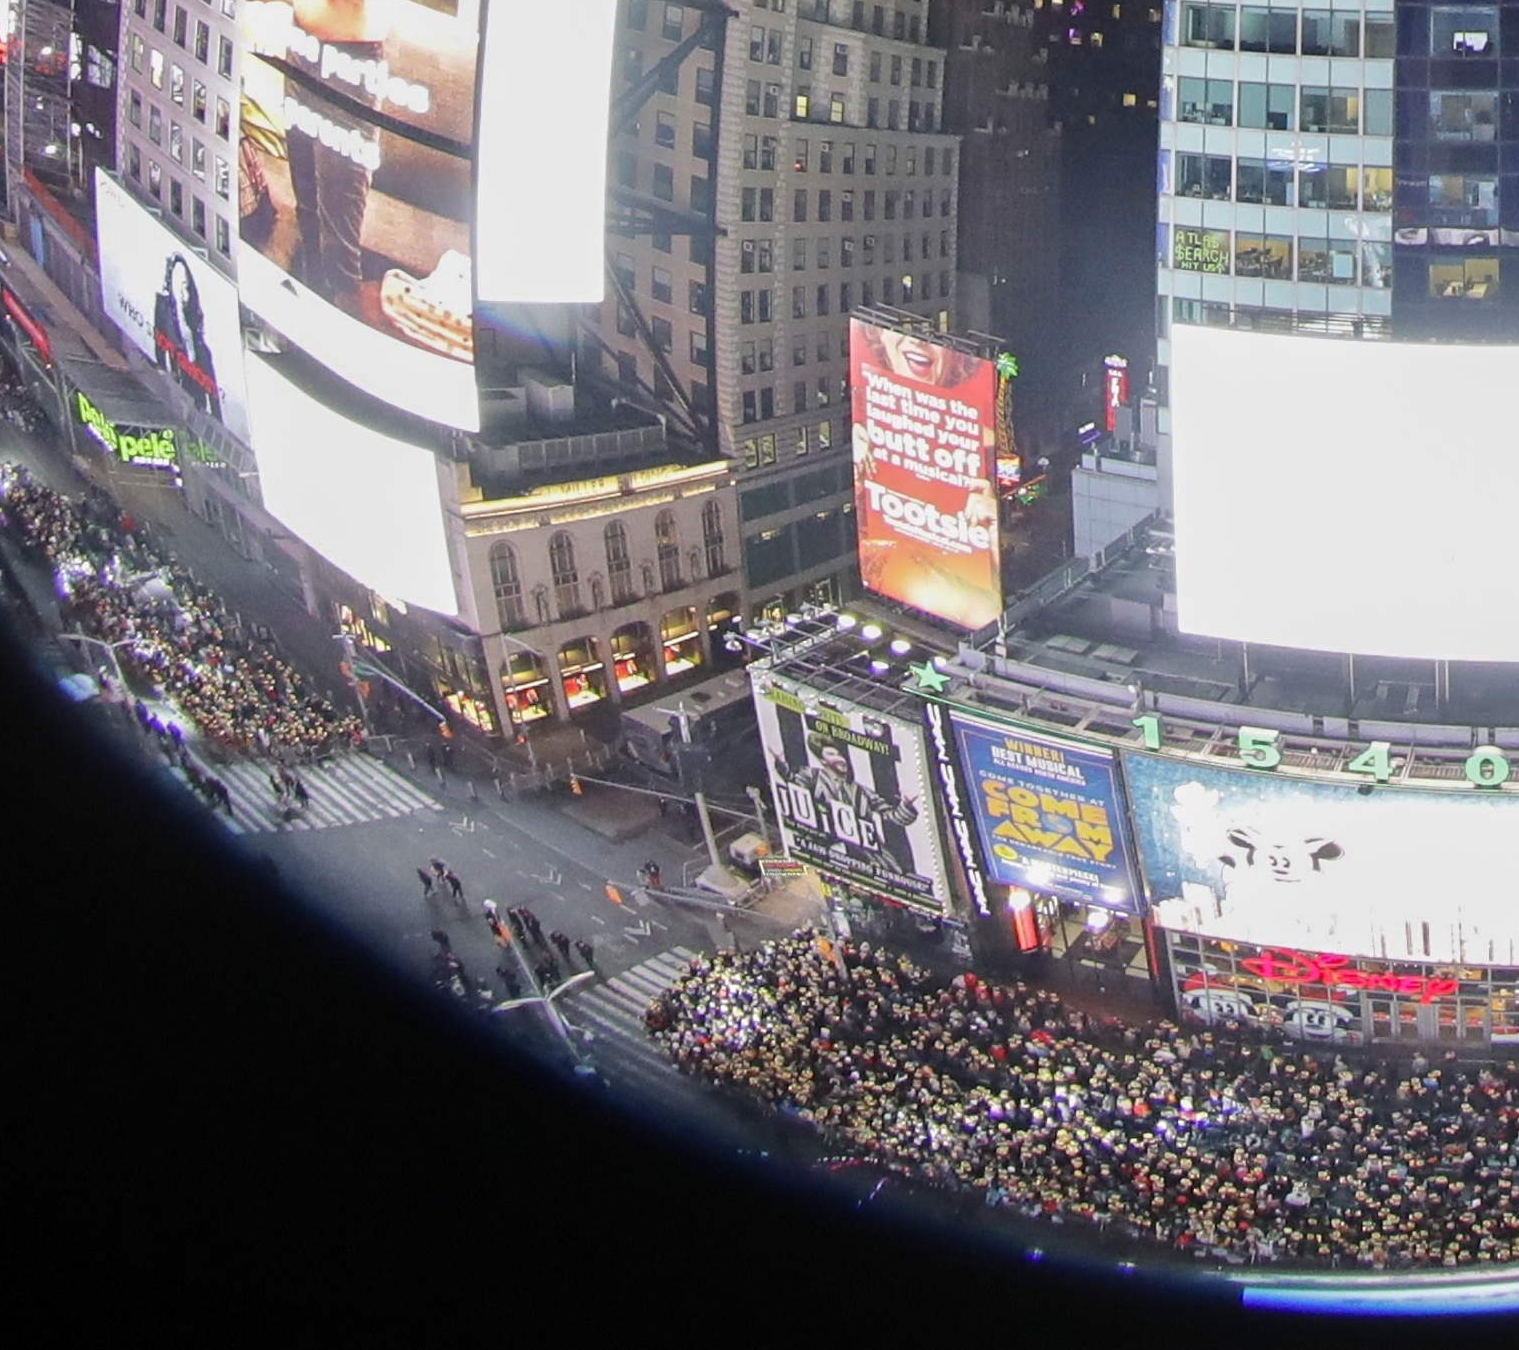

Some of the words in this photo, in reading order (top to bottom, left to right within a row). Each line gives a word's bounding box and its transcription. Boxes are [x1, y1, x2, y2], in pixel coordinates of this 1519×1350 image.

[866, 385, 897, 411] last
[901, 396, 940, 424] time
[945, 413, 979, 436] you
[916, 388, 946, 411] was
[949, 401, 978, 419] the
[867, 402, 934, 437] laughed
[938, 426, 979, 450] your
[867, 419, 930, 463] butt
[934, 448, 981, 478] off
[873, 447, 889, 462] at
[892, 454, 901, 466] a
[560, 477, 605, 495] MILLER
[864, 480, 990, 549] Tootsie
[833, 725, 890, 755] BROADWAY!
[1005, 737, 1064, 764] WINNER!
[1132, 712, 1510, 787] 1540
[992, 746, 1022, 764] BEST
[1025, 755, 1084, 779] MUSICAL
[979, 769, 1014, 785] COME
[1018, 779, 1087, 803] TOGETHER
[1090, 799, 1106, 807] AT
[982, 780, 1108, 826] COME
[992, 819, 1114, 862] AWAY
[1241, 947, 1459, 1005] Disney
